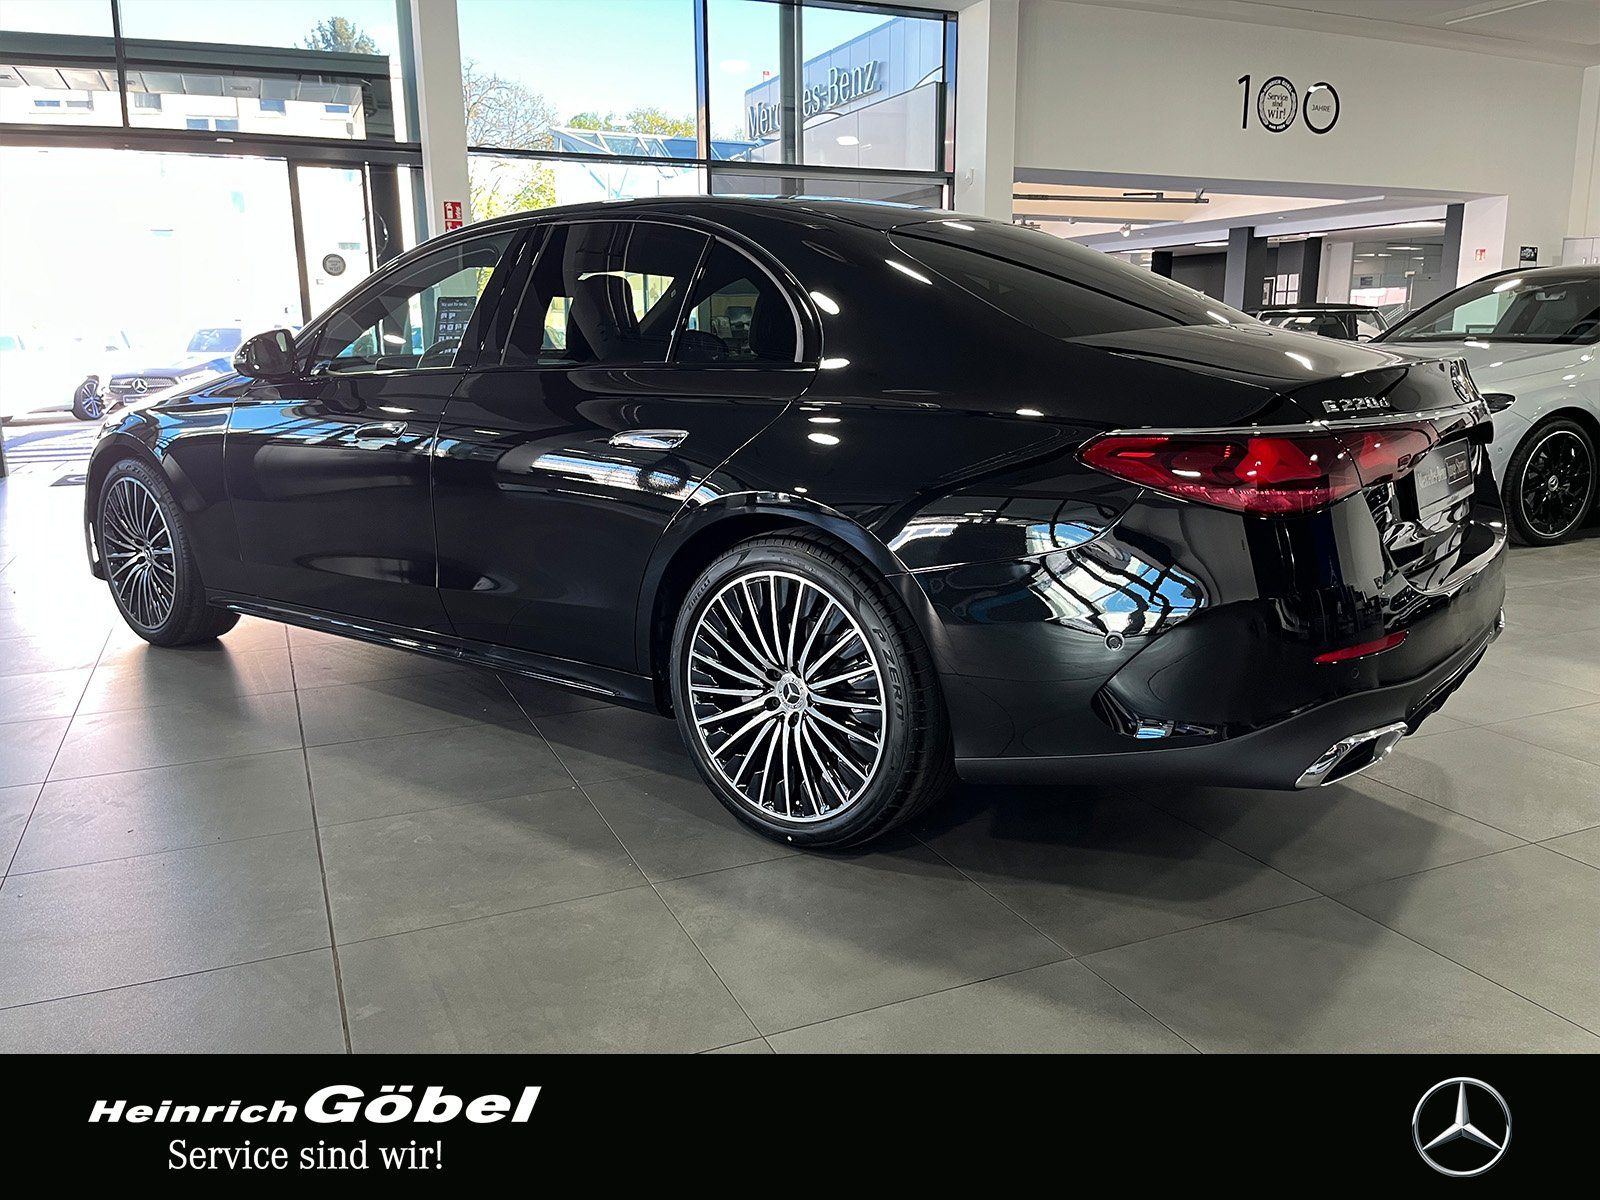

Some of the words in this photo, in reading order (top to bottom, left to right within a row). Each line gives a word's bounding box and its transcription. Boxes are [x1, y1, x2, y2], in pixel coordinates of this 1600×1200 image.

[748, 60, 879, 138] Merces-Benz
[1267, 107, 1286, 120] wir!
[1311, 104, 1331, 113] JAHRE
[872, 628, 887, 642] P
[882, 649, 905, 721] ZERO
